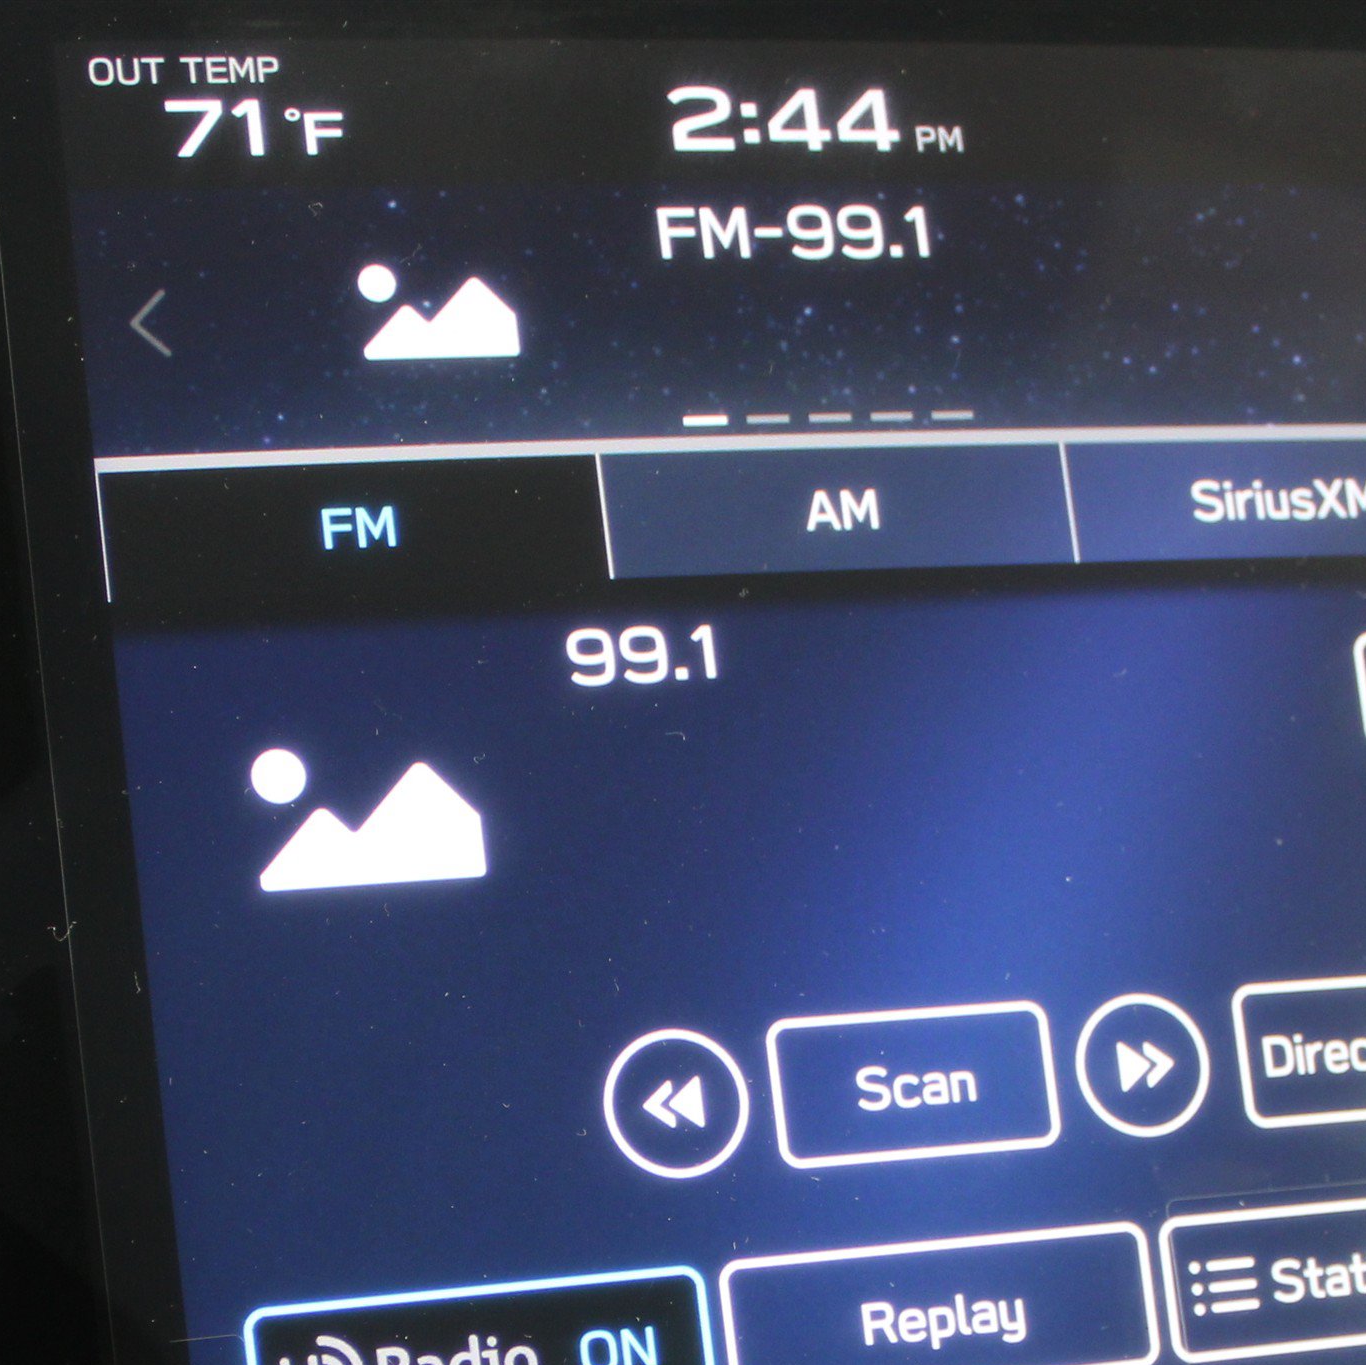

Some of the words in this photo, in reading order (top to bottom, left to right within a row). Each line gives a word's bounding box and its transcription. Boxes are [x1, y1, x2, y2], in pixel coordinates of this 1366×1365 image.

[88, 56, 165, 87] OUT
[179, 55, 280, 84] TEMP
[666, 84, 901, 152] 2:44
[914, 124, 964, 153] PM
[655, 203, 930, 260] FM-99.1
[320, 505, 400, 551] FM
[806, 488, 880, 532] AM
[565, 624, 718, 688] 99.1
[855, 1066, 977, 1112] Scan
[860, 1293, 1027, 1350] Replay
